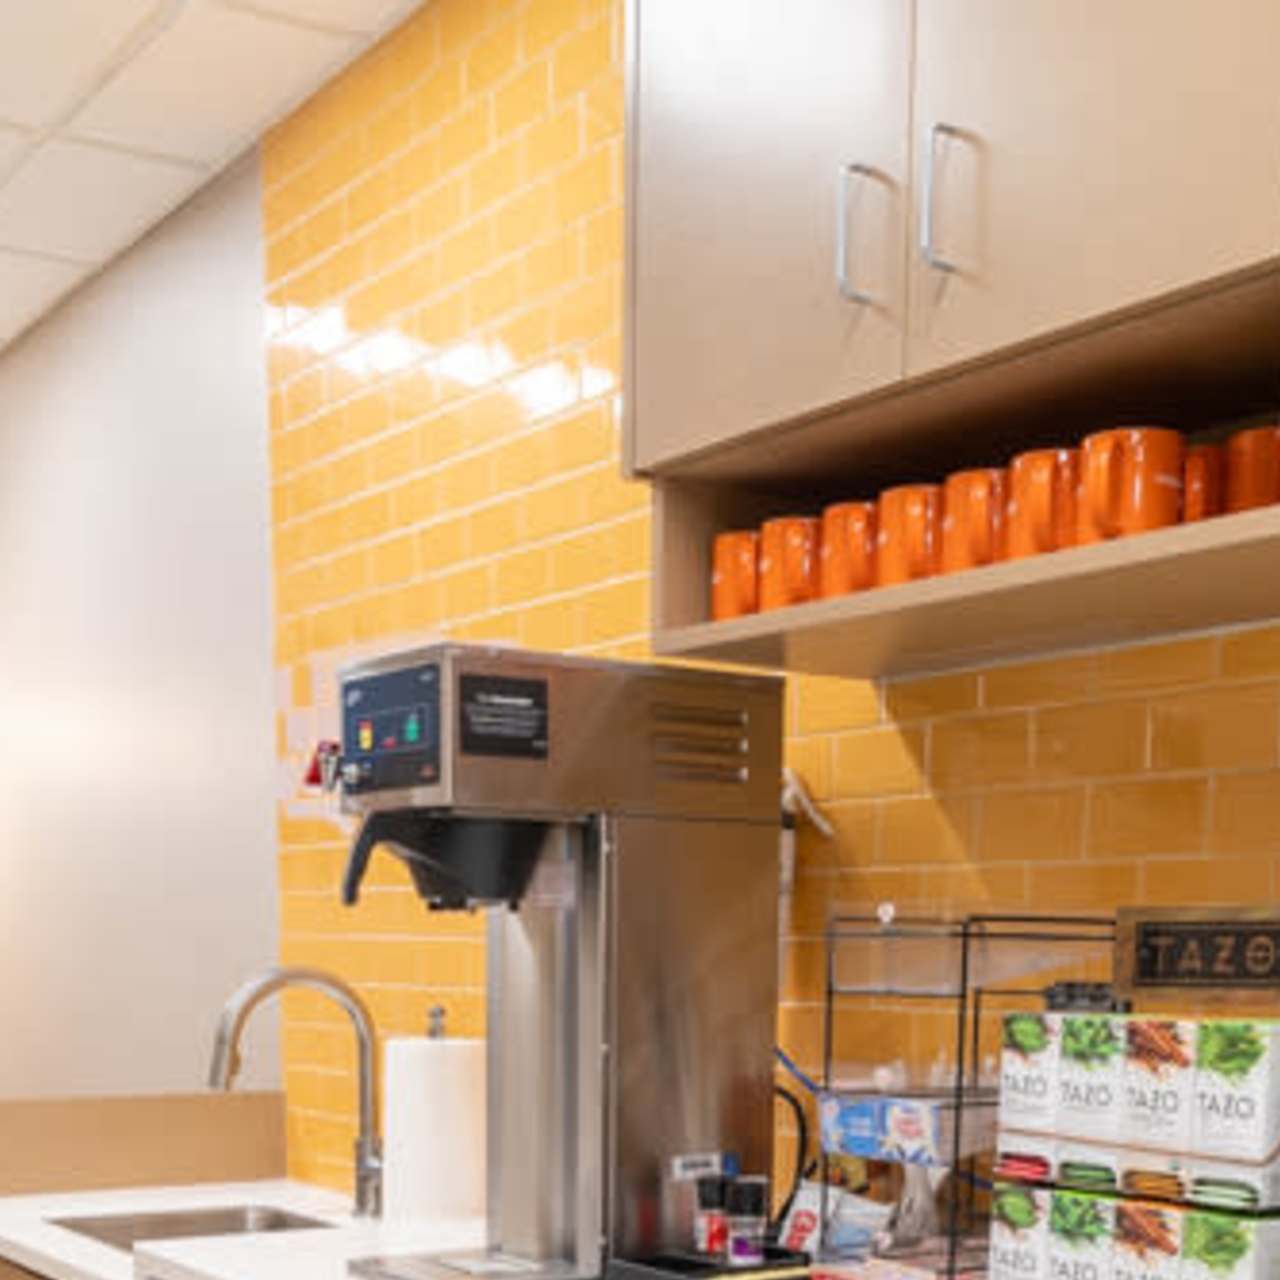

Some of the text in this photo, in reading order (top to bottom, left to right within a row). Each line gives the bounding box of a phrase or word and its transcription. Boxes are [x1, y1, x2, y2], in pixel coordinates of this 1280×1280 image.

[1147, 935, 1276, 974] TAZO
[1004, 1073, 1048, 1098] TAZO
[1061, 1081, 1113, 1107] TAZO
[1125, 1087, 1179, 1113] TAZO
[1198, 1093, 1256, 1119] TAZO
[992, 1248, 1038, 1272] TAZO
